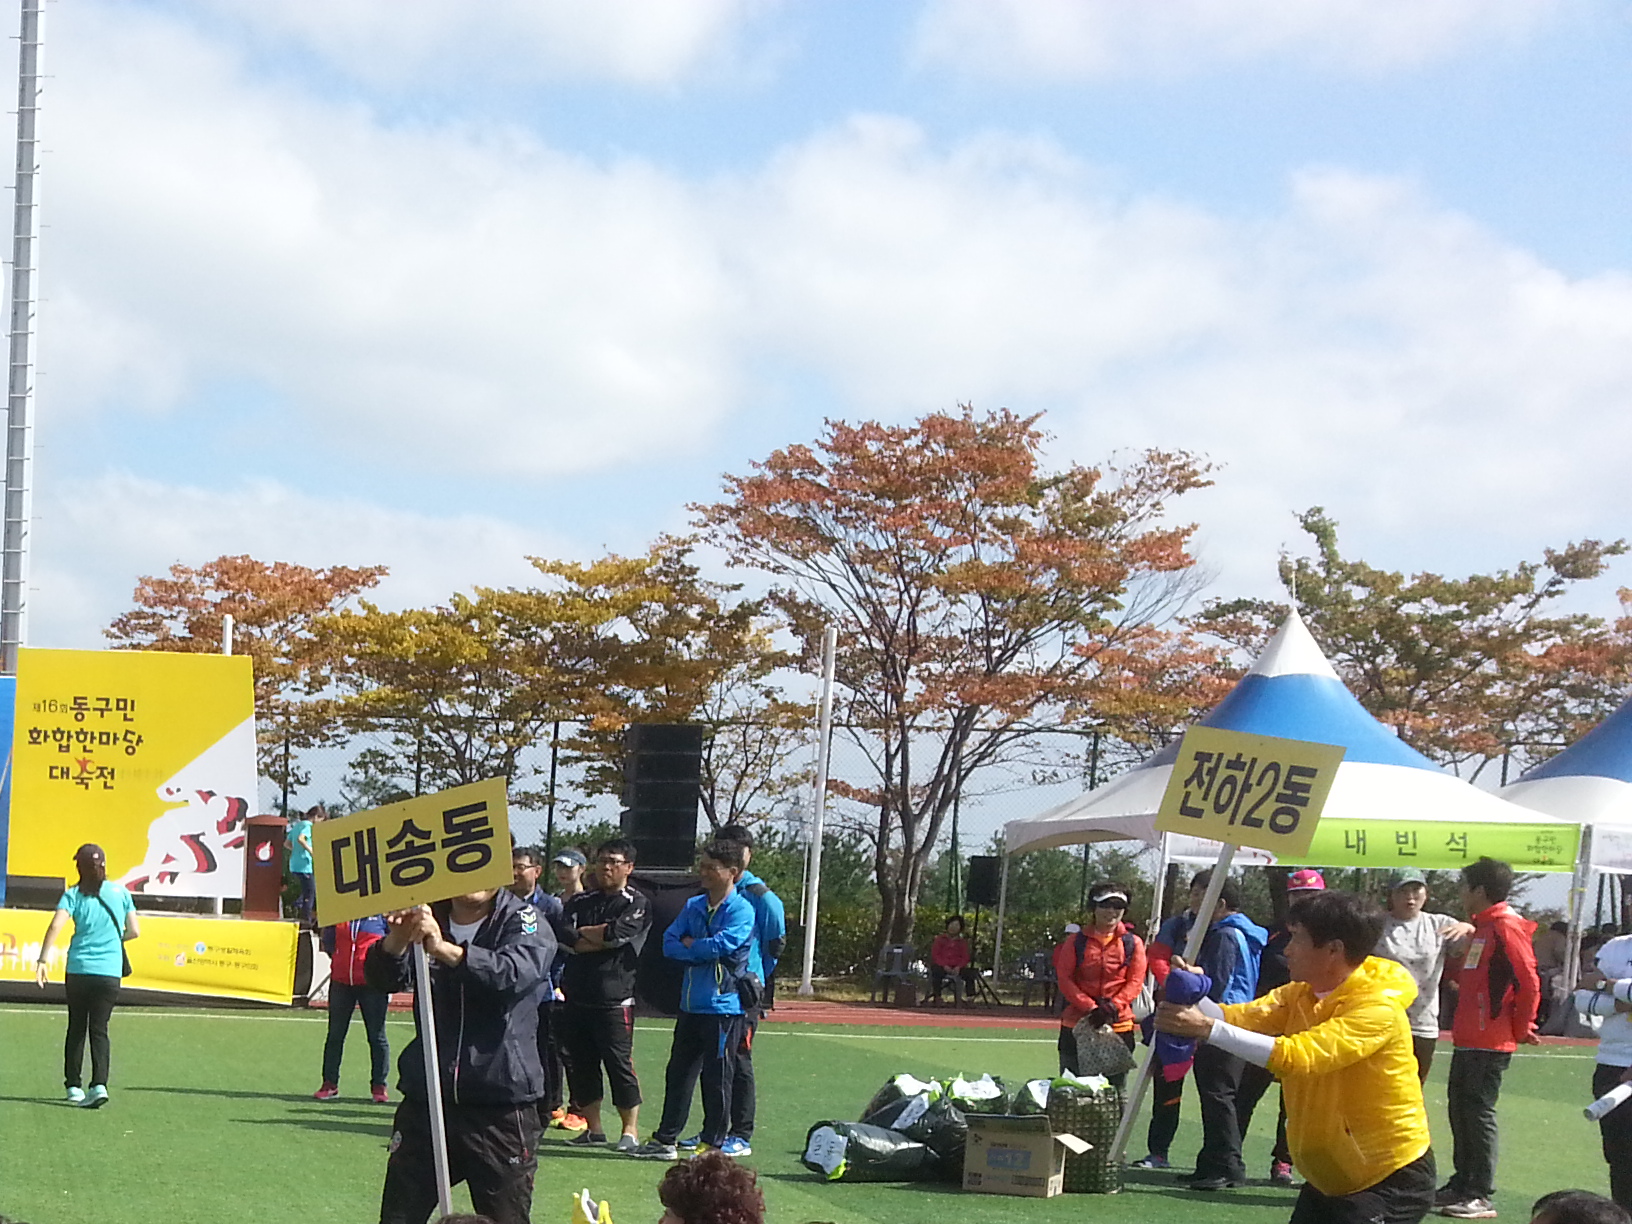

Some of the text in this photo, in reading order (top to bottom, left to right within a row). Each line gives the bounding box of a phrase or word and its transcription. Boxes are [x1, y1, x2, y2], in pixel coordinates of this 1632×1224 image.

[33, 696, 136, 722] 제16회 동구민
[28, 727, 144, 756] 화합한마당
[49, 757, 116, 790] 대축전
[1179, 751, 1318, 834] 전하2동
[331, 801, 494, 898] 대송동
